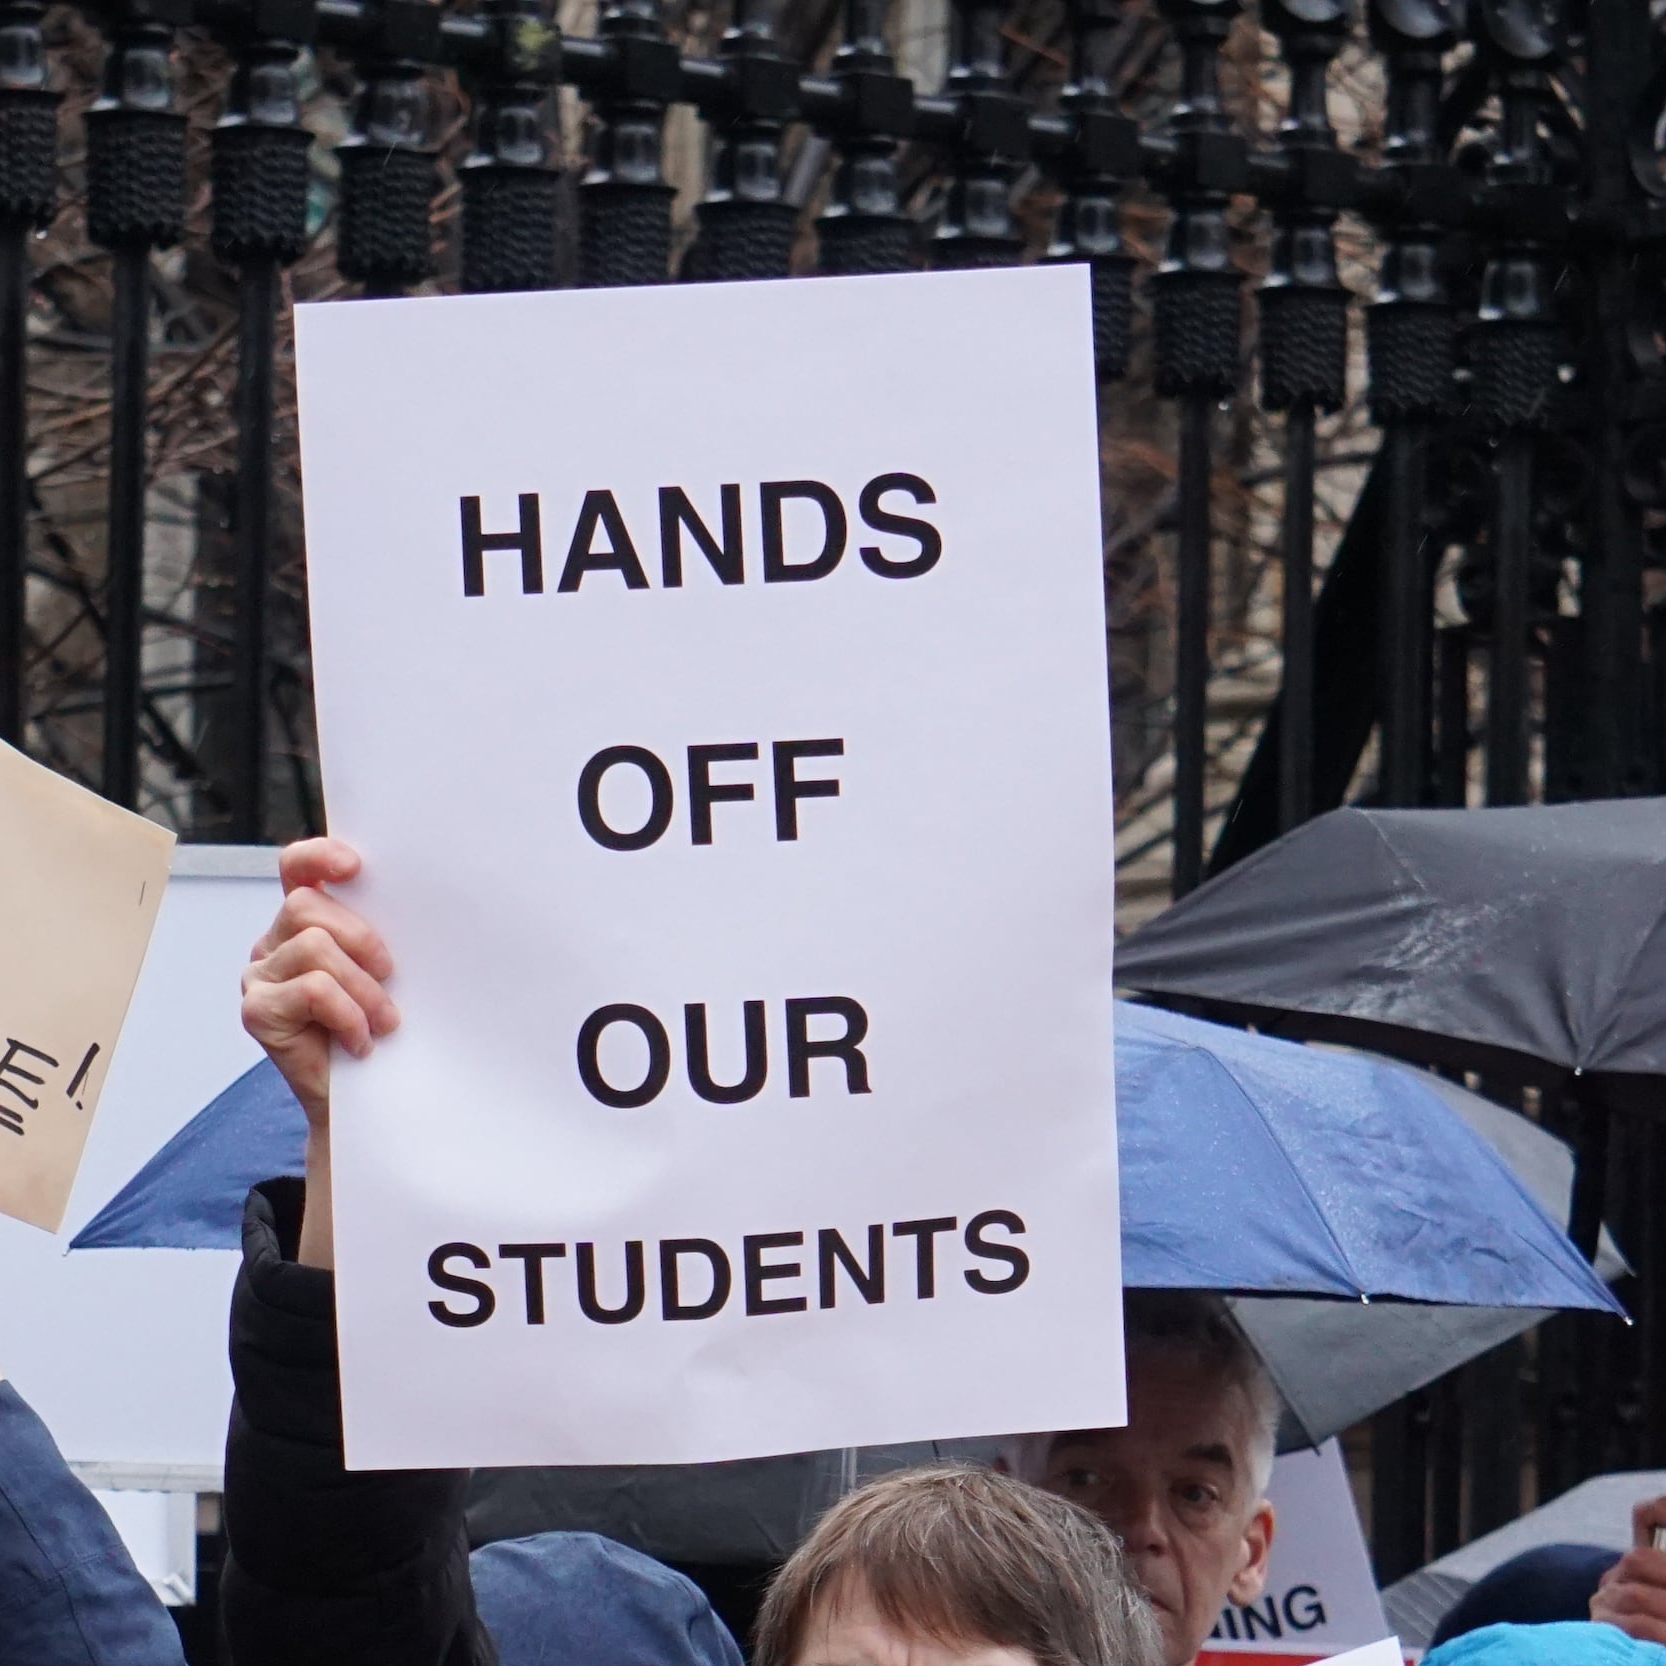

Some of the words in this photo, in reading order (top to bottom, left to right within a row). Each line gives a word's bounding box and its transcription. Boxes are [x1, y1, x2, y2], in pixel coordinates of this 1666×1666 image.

[459, 472, 945, 598] HANDS
[577, 738, 846, 852] OFF
[576, 997, 874, 1109] OUR
[425, 1209, 1032, 1329] STUDENTS
[1210, 1584, 1326, 1641] ING
